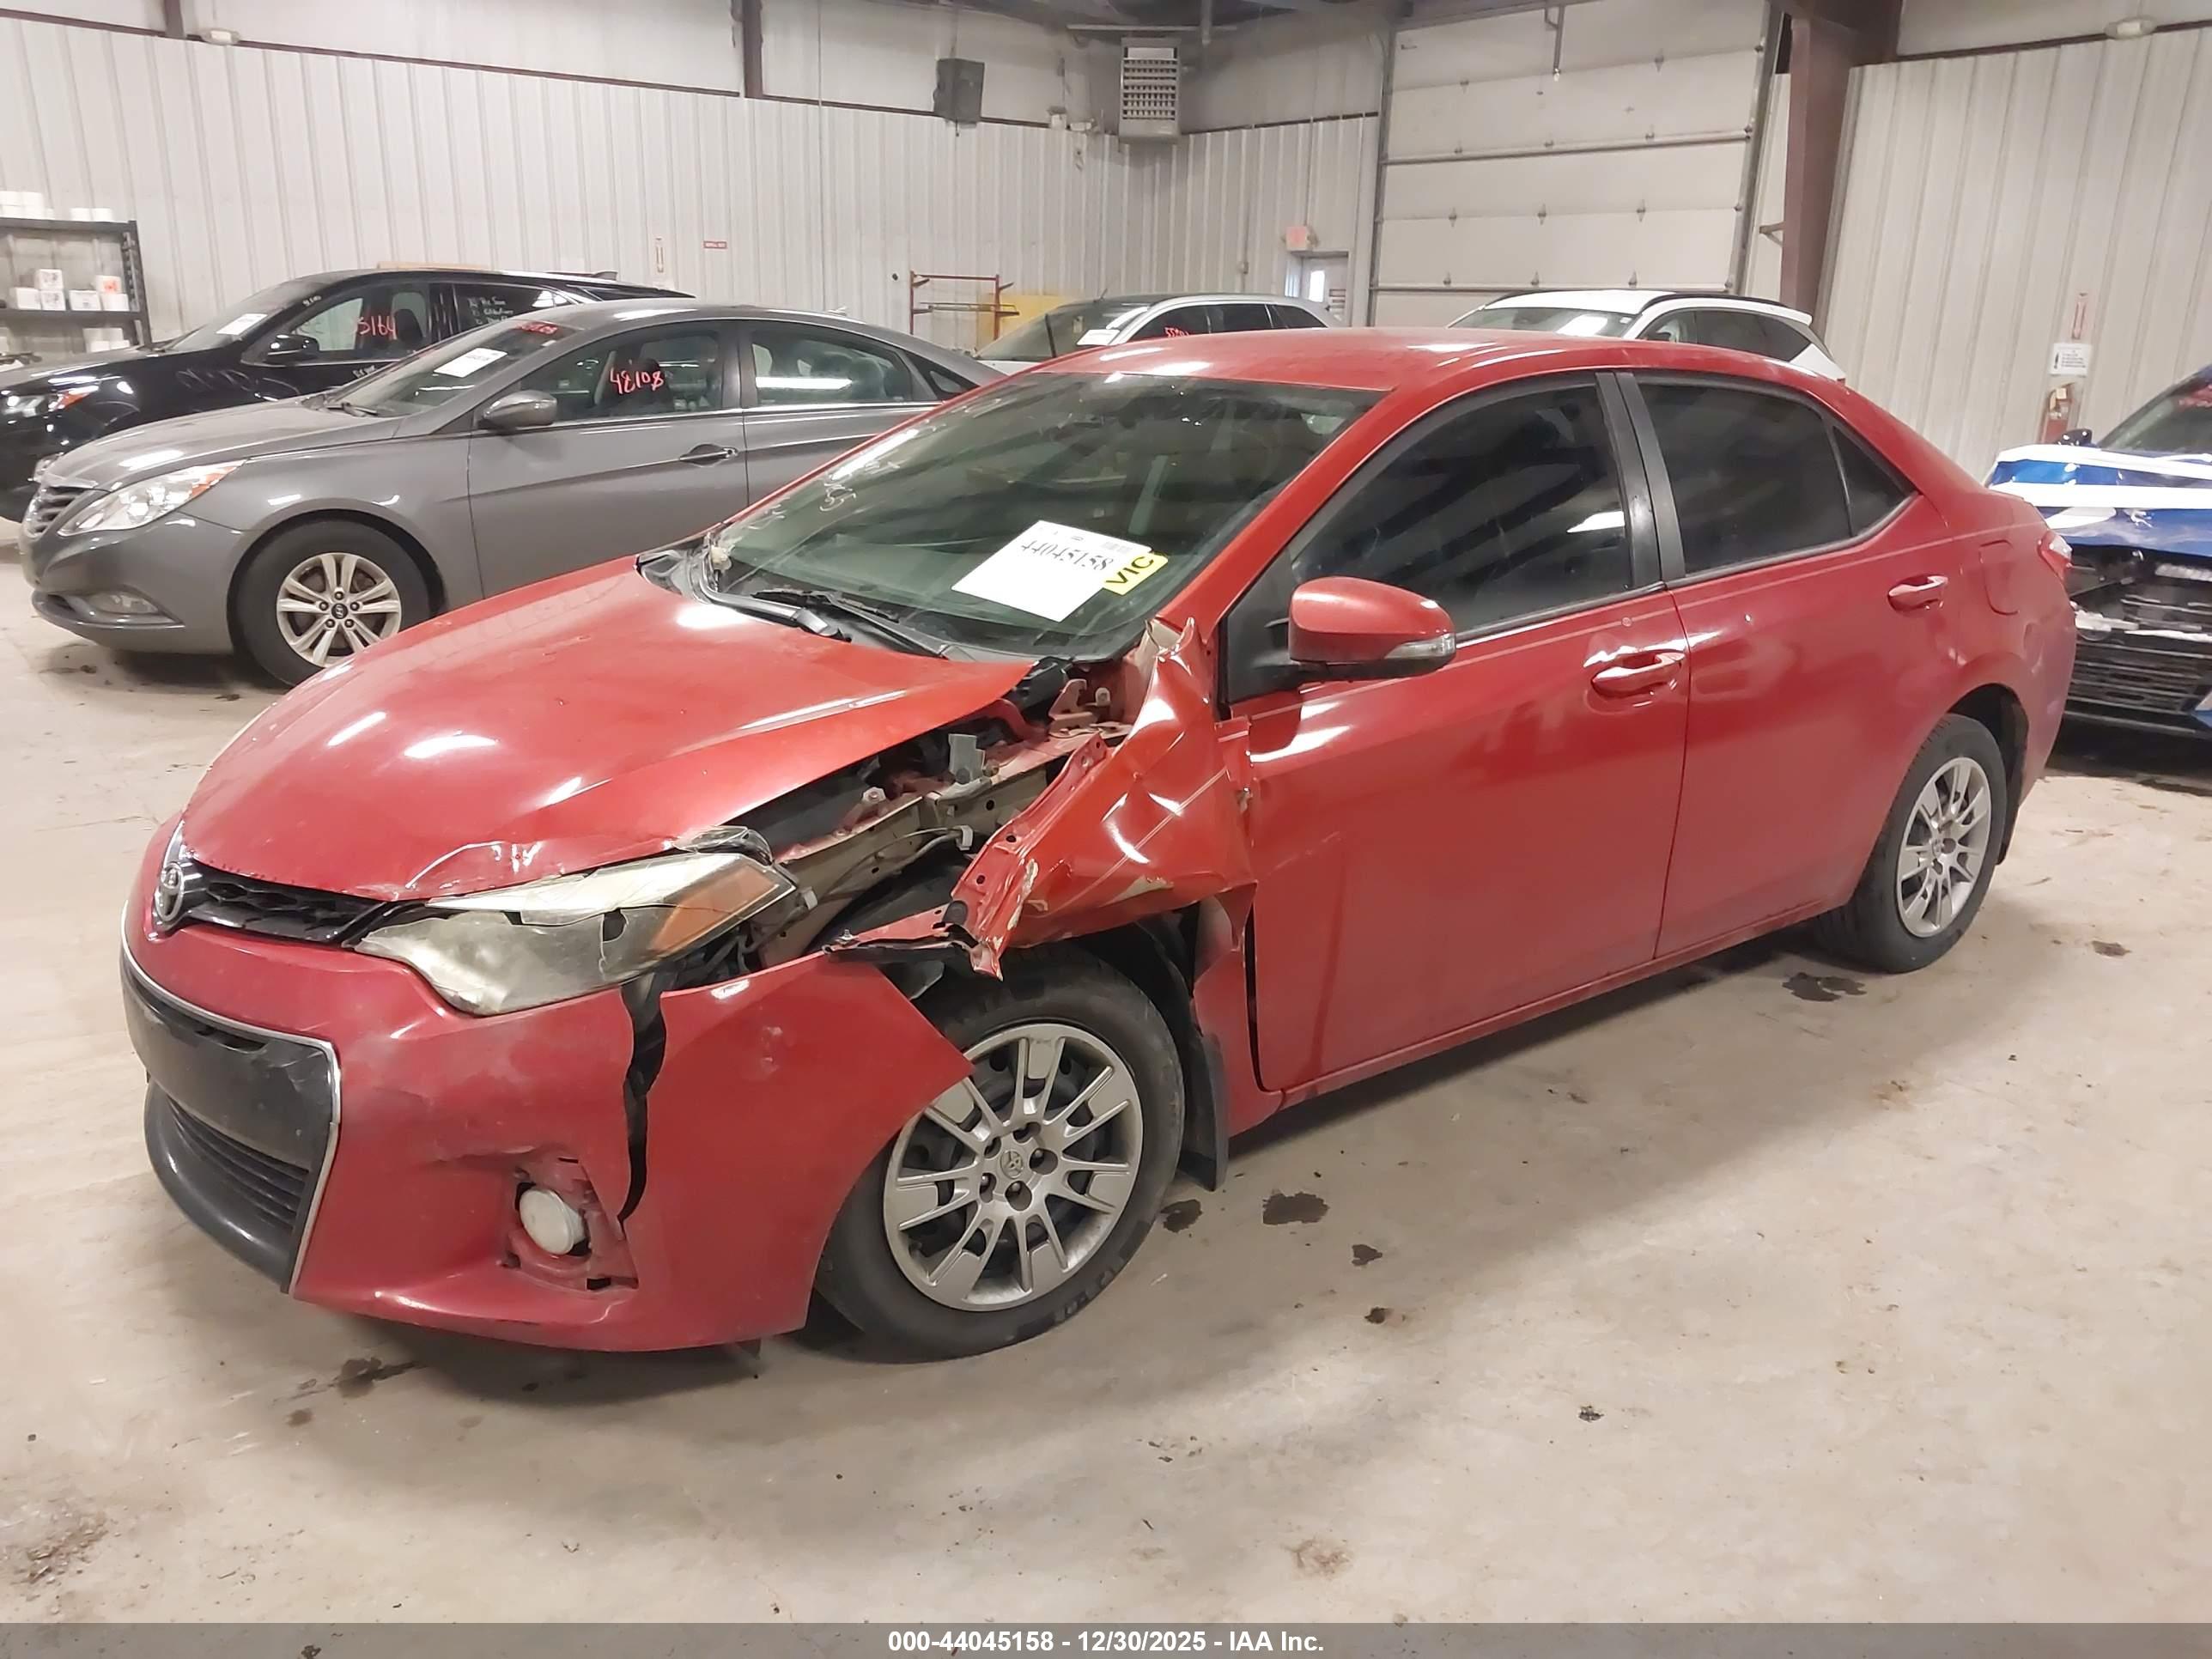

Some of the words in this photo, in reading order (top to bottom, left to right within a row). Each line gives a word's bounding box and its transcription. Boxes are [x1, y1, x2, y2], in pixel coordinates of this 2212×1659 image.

[609, 367, 665, 395] 48108
[1020, 539, 1114, 571] 44045158
[1104, 556, 1155, 586] VIC
